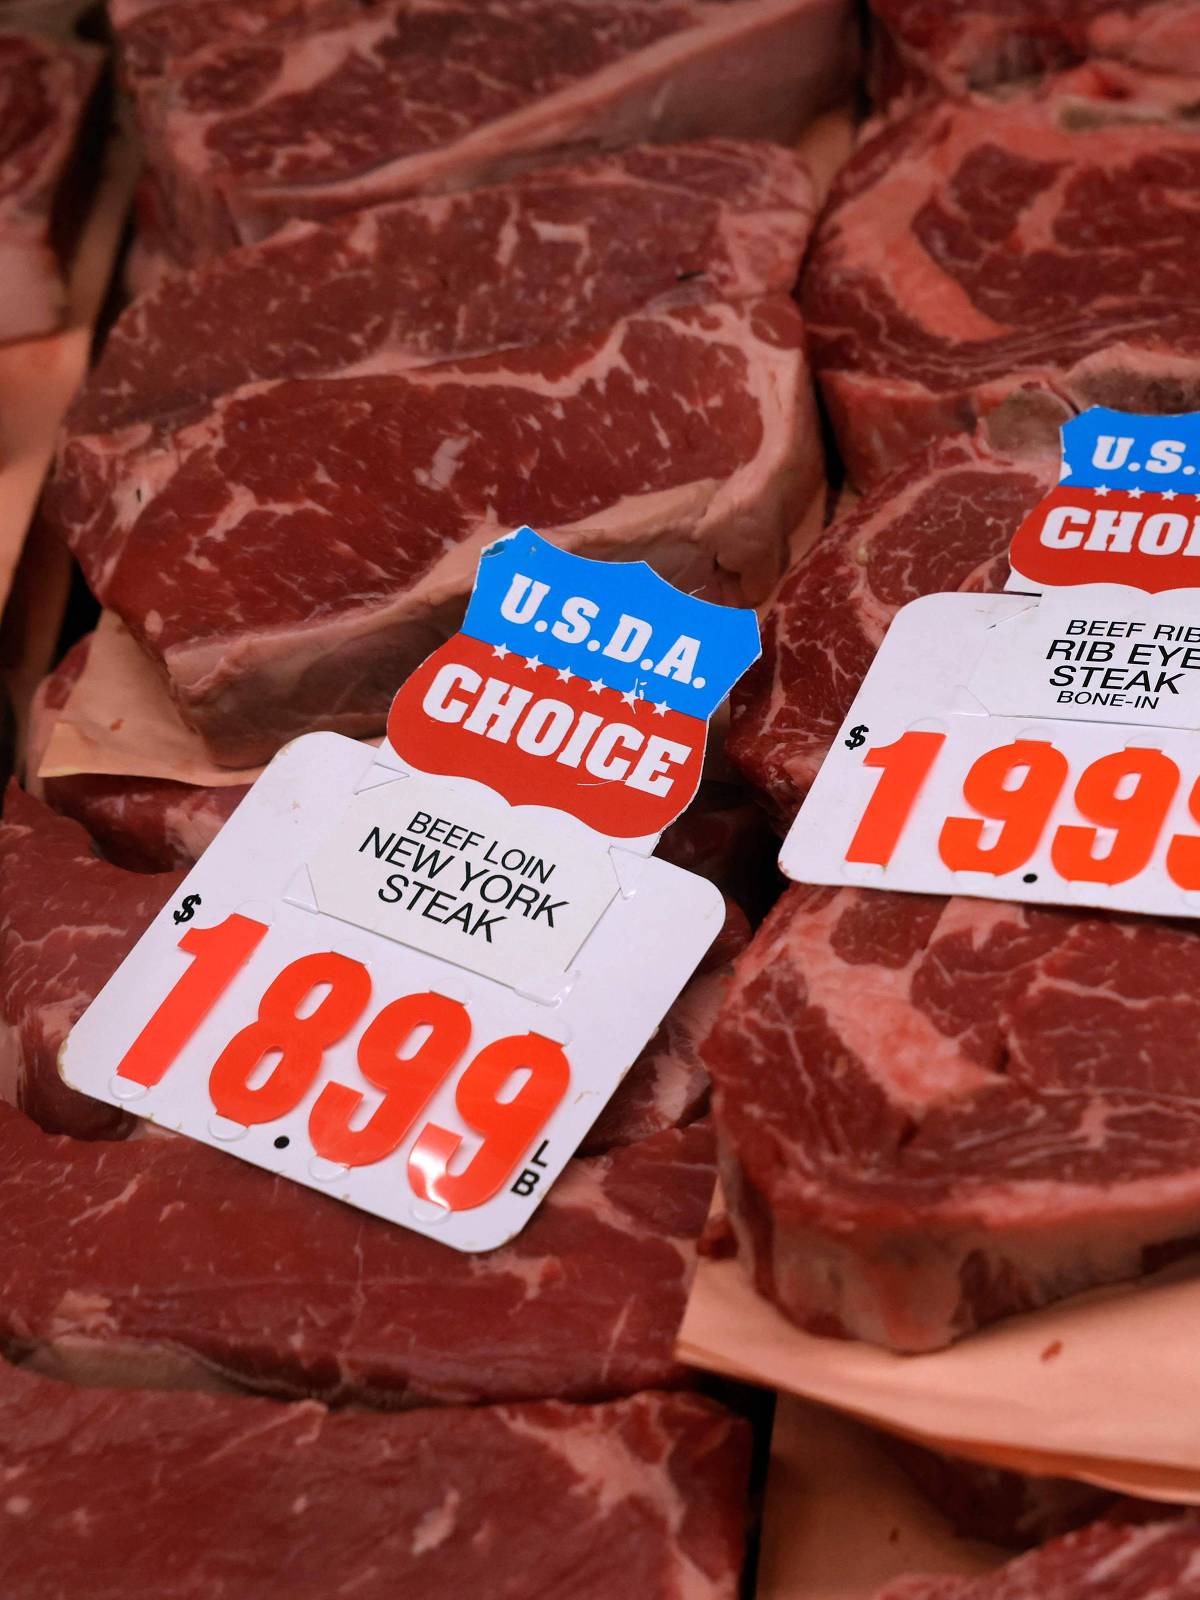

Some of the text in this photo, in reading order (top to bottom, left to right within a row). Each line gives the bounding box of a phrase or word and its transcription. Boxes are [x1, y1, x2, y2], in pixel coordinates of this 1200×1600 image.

[500, 572, 707, 690] U.S.D.A.
[1046, 640, 1114, 662] RIB
[1065, 619, 1146, 638] BEEF
[1049, 666, 1186, 694] STEAK
[1056, 690, 1160, 710] BONE-IN
[421, 663, 693, 799] CHOICE
[358, 826, 570, 928] NEW YORK
[406, 811, 557, 886] BEEF LOIN
[378, 875, 508, 943] STEAK
